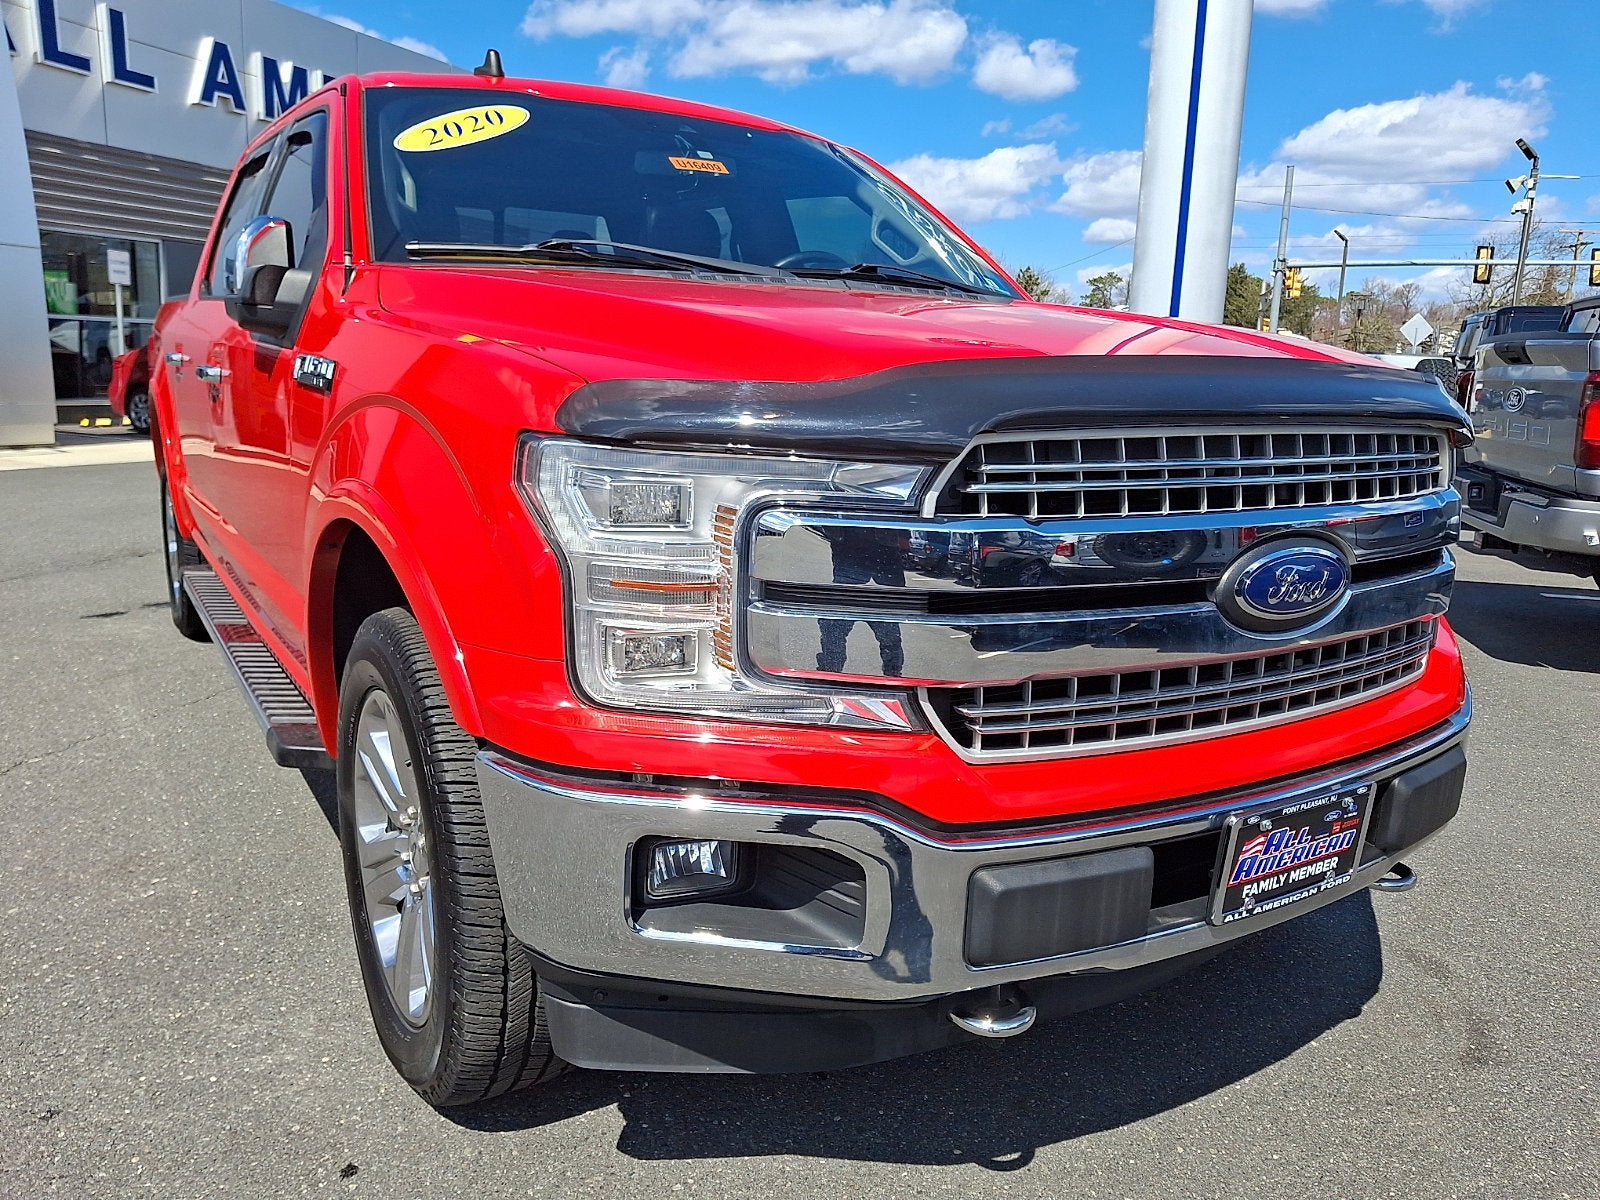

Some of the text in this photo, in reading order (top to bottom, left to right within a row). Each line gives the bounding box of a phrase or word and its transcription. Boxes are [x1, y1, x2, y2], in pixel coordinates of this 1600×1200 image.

[3, 0, 335, 120] LL AM
[421, 110, 504, 145] 2020
[675, 159, 722, 172] U16409
[1267, 564, 1329, 605] Ford
[1282, 804, 1301, 815] POINT
[1230, 829, 1356, 884] AMERICAN
[1262, 827, 1311, 856] ALL
[1242, 857, 1339, 898] FAMILY MEMBER
[1224, 875, 1351, 923] ALL AMERICAN FORD
